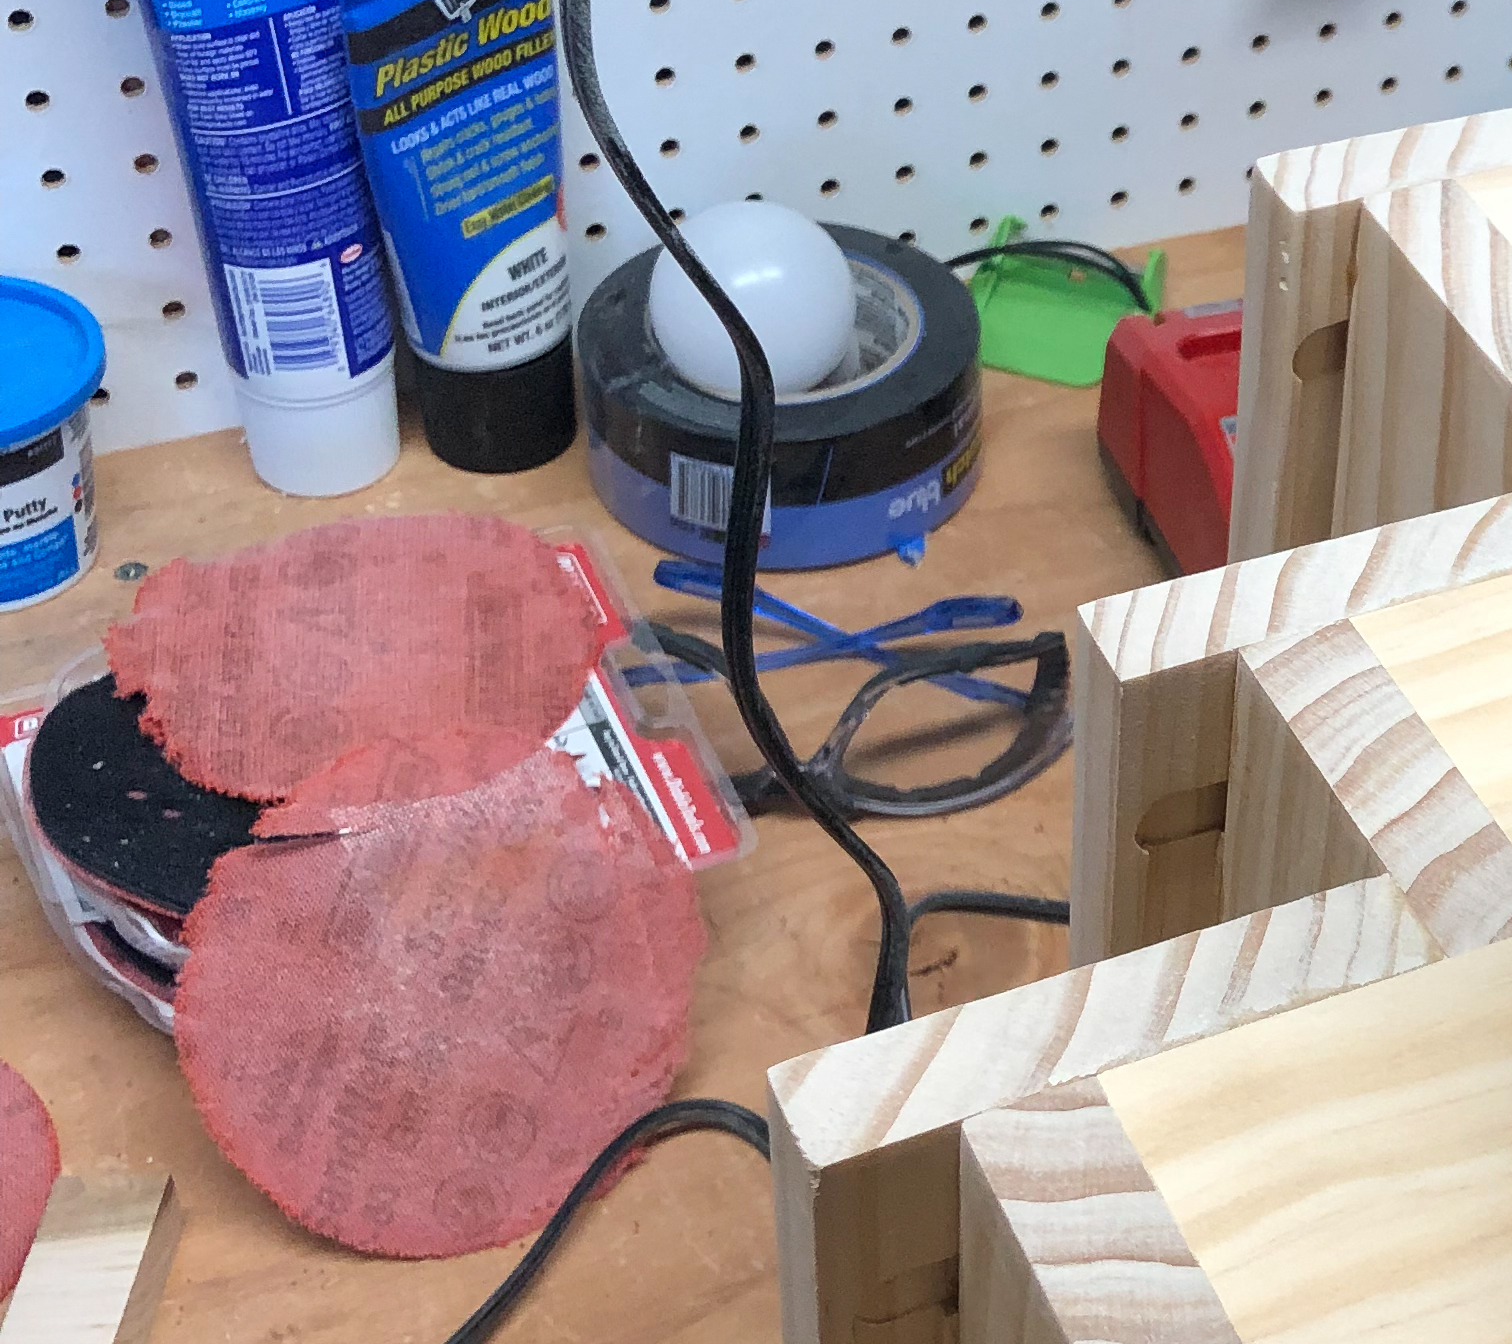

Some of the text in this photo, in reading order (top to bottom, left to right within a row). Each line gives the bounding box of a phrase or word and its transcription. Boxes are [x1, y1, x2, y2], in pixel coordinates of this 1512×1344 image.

[375, 32, 469, 97] Plastic
[383, 102, 411, 126] ALL
[411, 68, 470, 112] PURPOSE
[472, 49, 513, 80] WOOD
[391, 128, 430, 155] LOOKS
[440, 105, 468, 131] ACTS
[467, 94, 493, 116] LIKE
[492, 81, 523, 104] REAL
[507, 246, 549, 281] WHITE
[4, 495, 48, 523] Putty
[888, 478, 941, 522] blue
